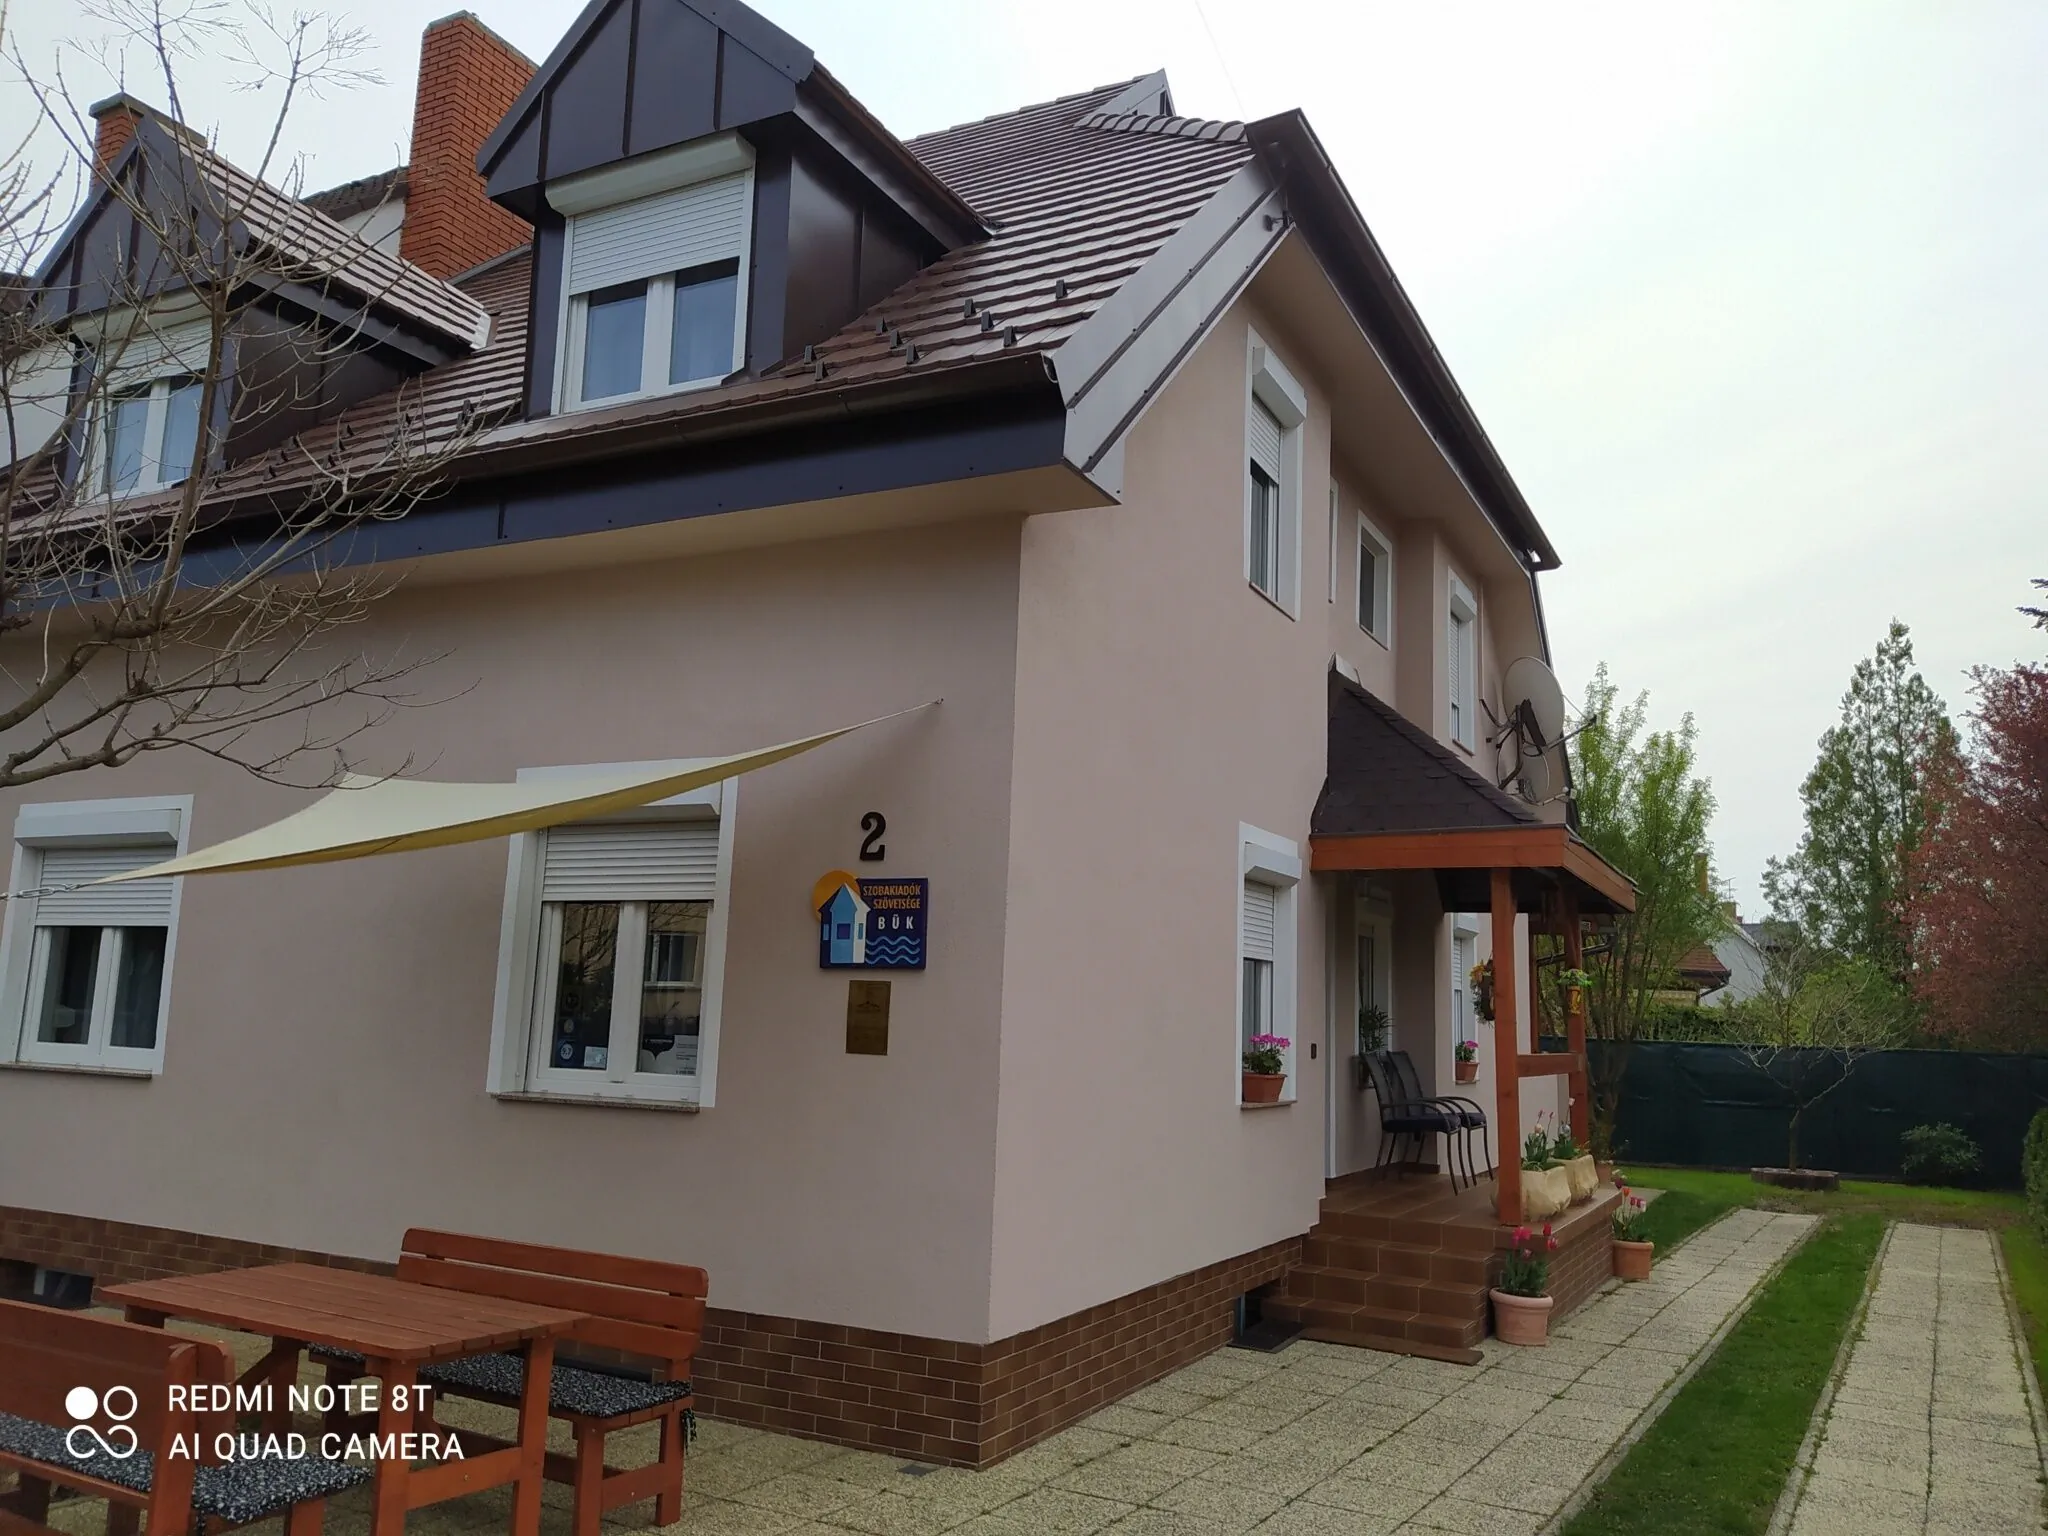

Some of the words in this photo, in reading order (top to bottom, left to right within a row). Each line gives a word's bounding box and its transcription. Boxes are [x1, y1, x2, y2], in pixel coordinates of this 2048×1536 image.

[860, 811, 886, 861] 2
[863, 883, 921, 896] SZOBAKIADÓK
[873, 896, 921, 910] SZÖVETSÉGE
